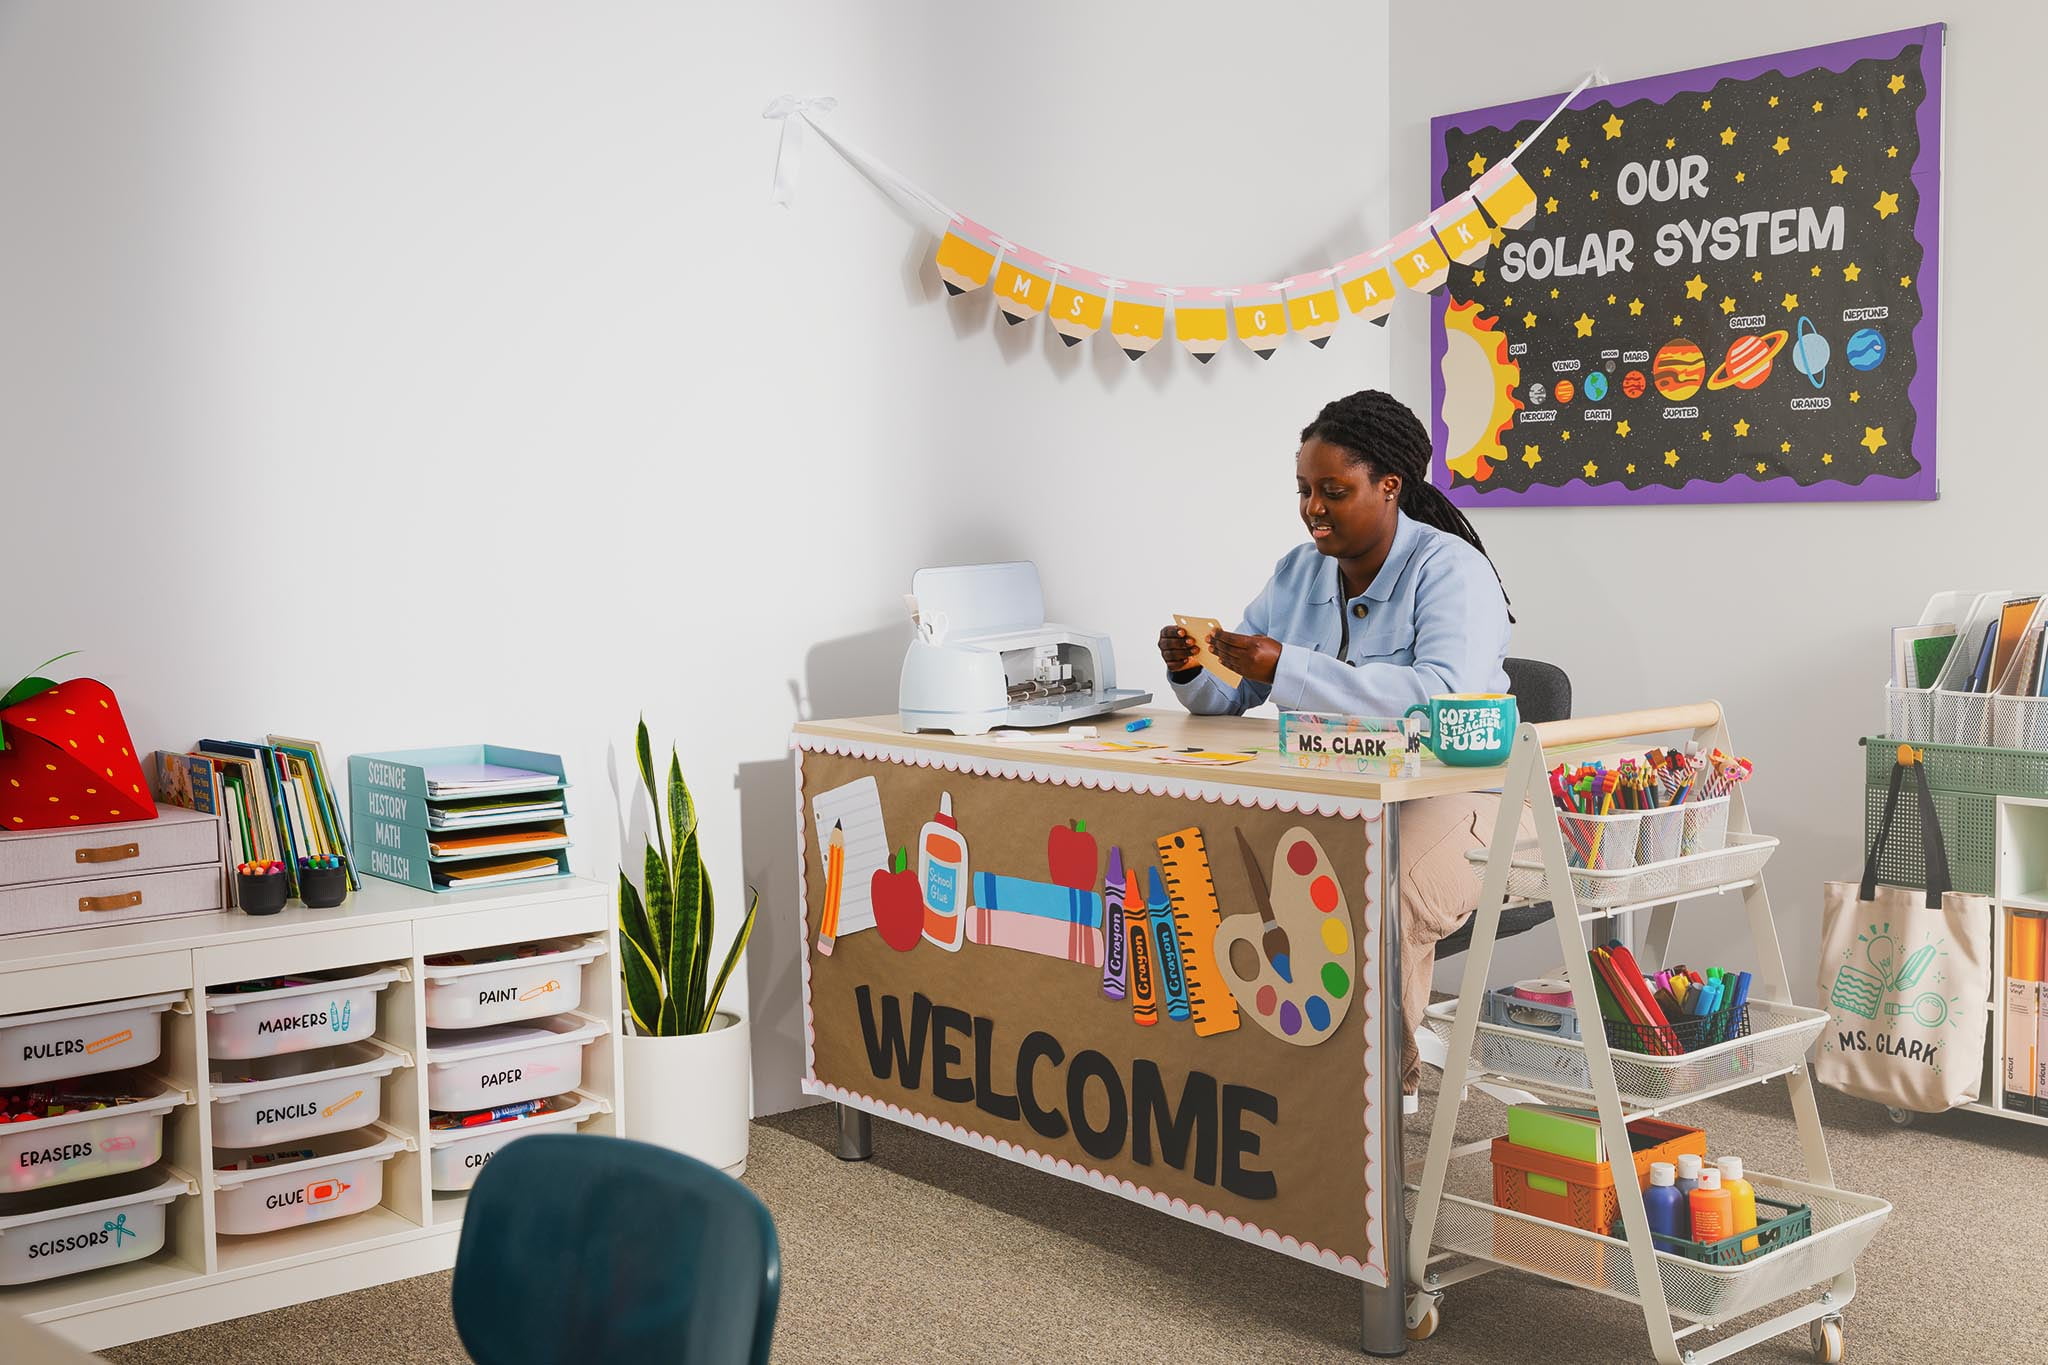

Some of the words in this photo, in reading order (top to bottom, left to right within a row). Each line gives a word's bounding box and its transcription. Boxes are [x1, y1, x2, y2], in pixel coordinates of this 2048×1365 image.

[1617, 155, 1709, 205] OUR
[1500, 229, 1634, 283] SOLAR
[1653, 206, 1845, 267] SYSTEM
[1254, 223, 1474, 331] CLARK
[1730, 316, 1765, 328] SATURN
[1844, 307, 1888, 321] NEPTUNE
[1510, 344, 1526, 354] SUN
[1602, 350, 1618, 358] MOON
[1624, 352, 1648, 362] MARS
[1553, 360, 1580, 371] VENUS
[1585, 410, 1611, 420] EARTH
[1663, 407, 1698, 419] JUPITER
[1792, 399, 1831, 410] URANUS
[1521, 411, 1556, 422] MERCURY
[1439, 707, 1501, 725] COFFEE
[1440, 721, 1448, 735] IS
[1451, 717, 1501, 736] TEACHER
[1299, 734, 1327, 753] MS.
[1332, 735, 1387, 757] CLARK
[1440, 728, 1501, 750] FUEL
[368, 761, 406, 791] SCIENCE
[369, 792, 407, 821] HISTORY
[375, 821, 401, 849] MATH
[371, 851, 410, 881] ENGLISH
[930, 866, 953, 890] School
[930, 884, 949, 904] Glue
[1110, 913, 1123, 971] Crayon
[1135, 935, 1149, 994] Crayon
[1162, 931, 1180, 991] Crayon
[479, 987, 518, 1006] PAINT
[258, 1012, 327, 1035] MARKERS
[23, 1039, 84, 1061] RULERS
[1838, 1030, 1872, 1052] MS.
[1876, 1032, 1938, 1066] CLARK
[481, 1069, 522, 1089] PAPER
[854, 984, 1278, 1199] WELCOME
[256, 1102, 317, 1125] PENCILS
[20, 1142, 92, 1168] ERASERS
[266, 1188, 304, 1210] GLUE
[28, 1229, 109, 1259] SCISSORS
